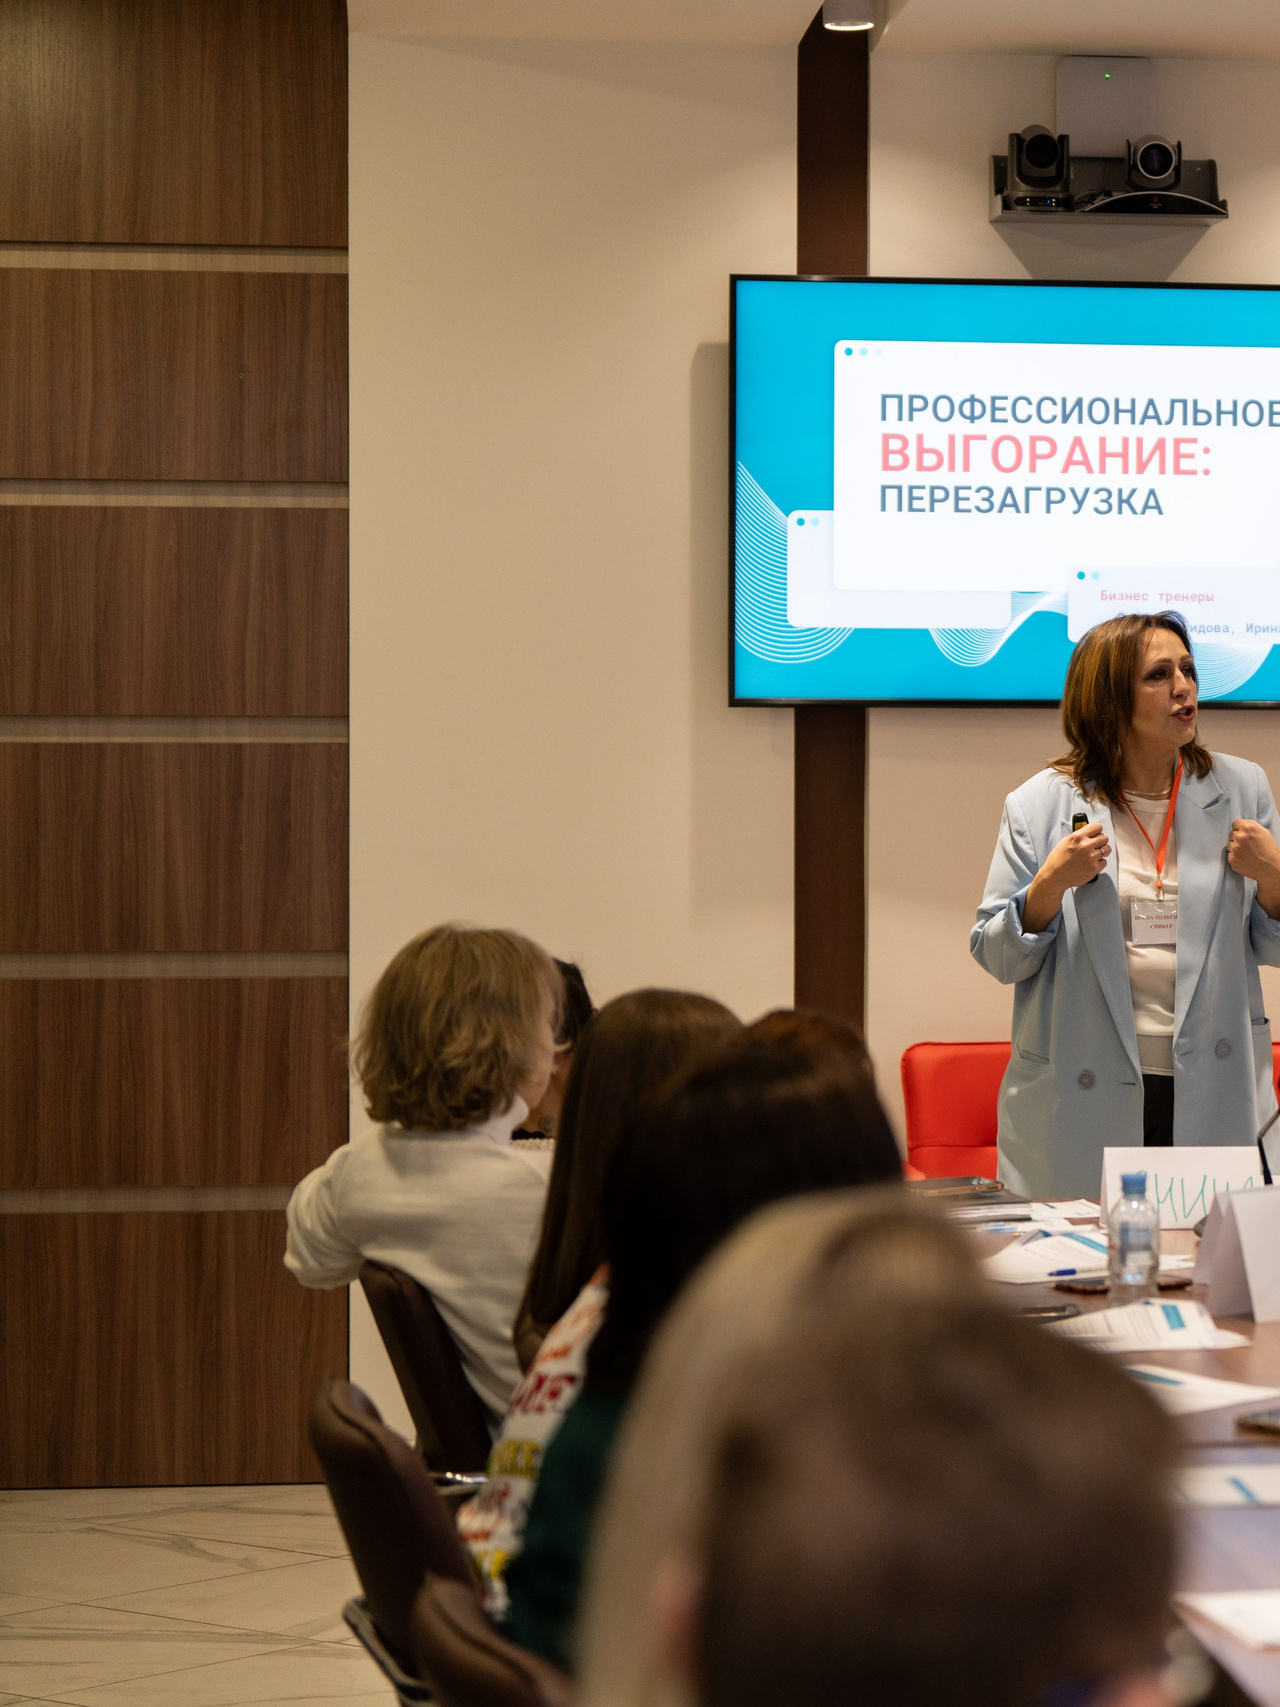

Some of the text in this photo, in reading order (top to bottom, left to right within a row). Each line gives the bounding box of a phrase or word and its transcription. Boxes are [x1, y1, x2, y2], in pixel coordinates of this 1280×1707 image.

[880, 432, 1212, 477] ВЫГОРАНИЕ:
[879, 484, 1165, 516] ПЕРЕЗАГРУЗКА
[1100, 589, 1214, 604] Бизнес тренеры
[1189, 623, 1235, 636] идова,
